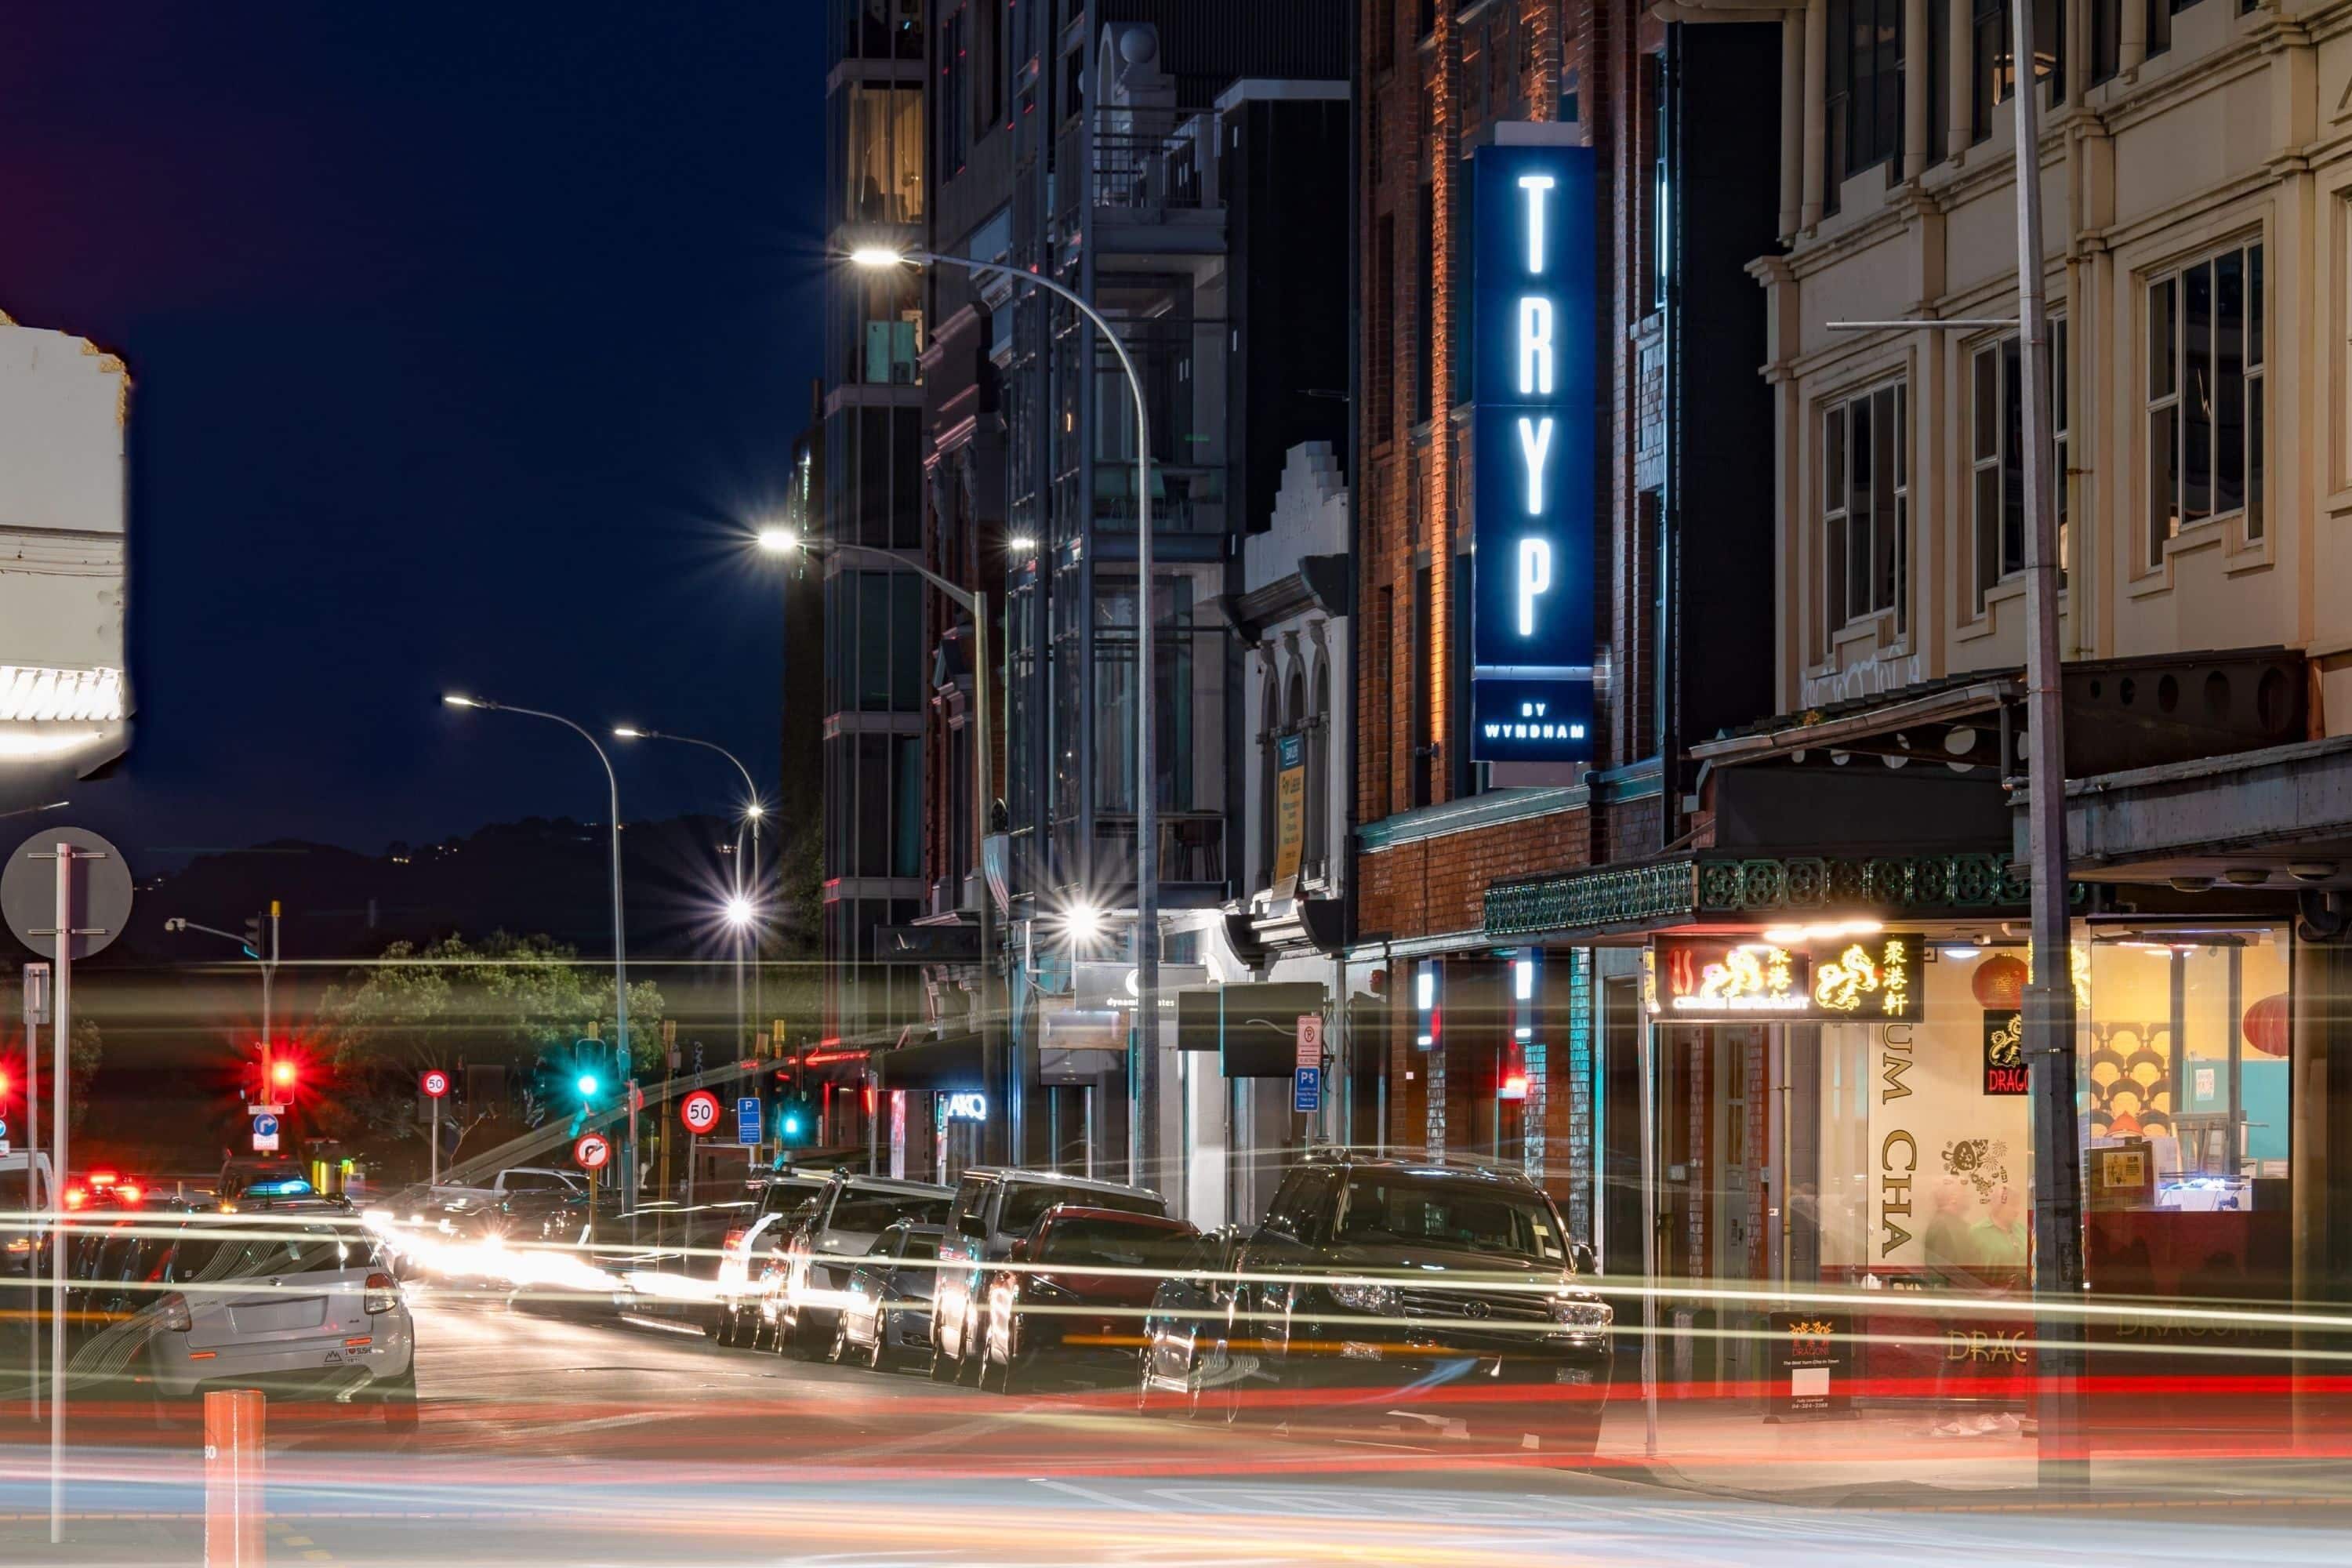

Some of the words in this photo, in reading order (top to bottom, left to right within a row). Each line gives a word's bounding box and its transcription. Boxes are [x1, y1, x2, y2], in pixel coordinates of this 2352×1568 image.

[1519, 176, 1554, 636] TRYP
[1523, 703, 1545, 717] BY
[1484, 724, 1584, 739] WYNDHAM
[1882, 941, 1908, 1017] 聚港軒
[1106, 997, 1138, 1007] dynami
[1882, 1022, 1913, 1105] UM
[429, 1079, 443, 1089] 50
[1988, 1069, 2032, 1092] DRAGO
[690, 1104, 710, 1120] 50
[746, 1101, 753, 1110] P
[1882, 1130, 1917, 1258] CHA
[1947, 1330, 2027, 1363] DRAG
